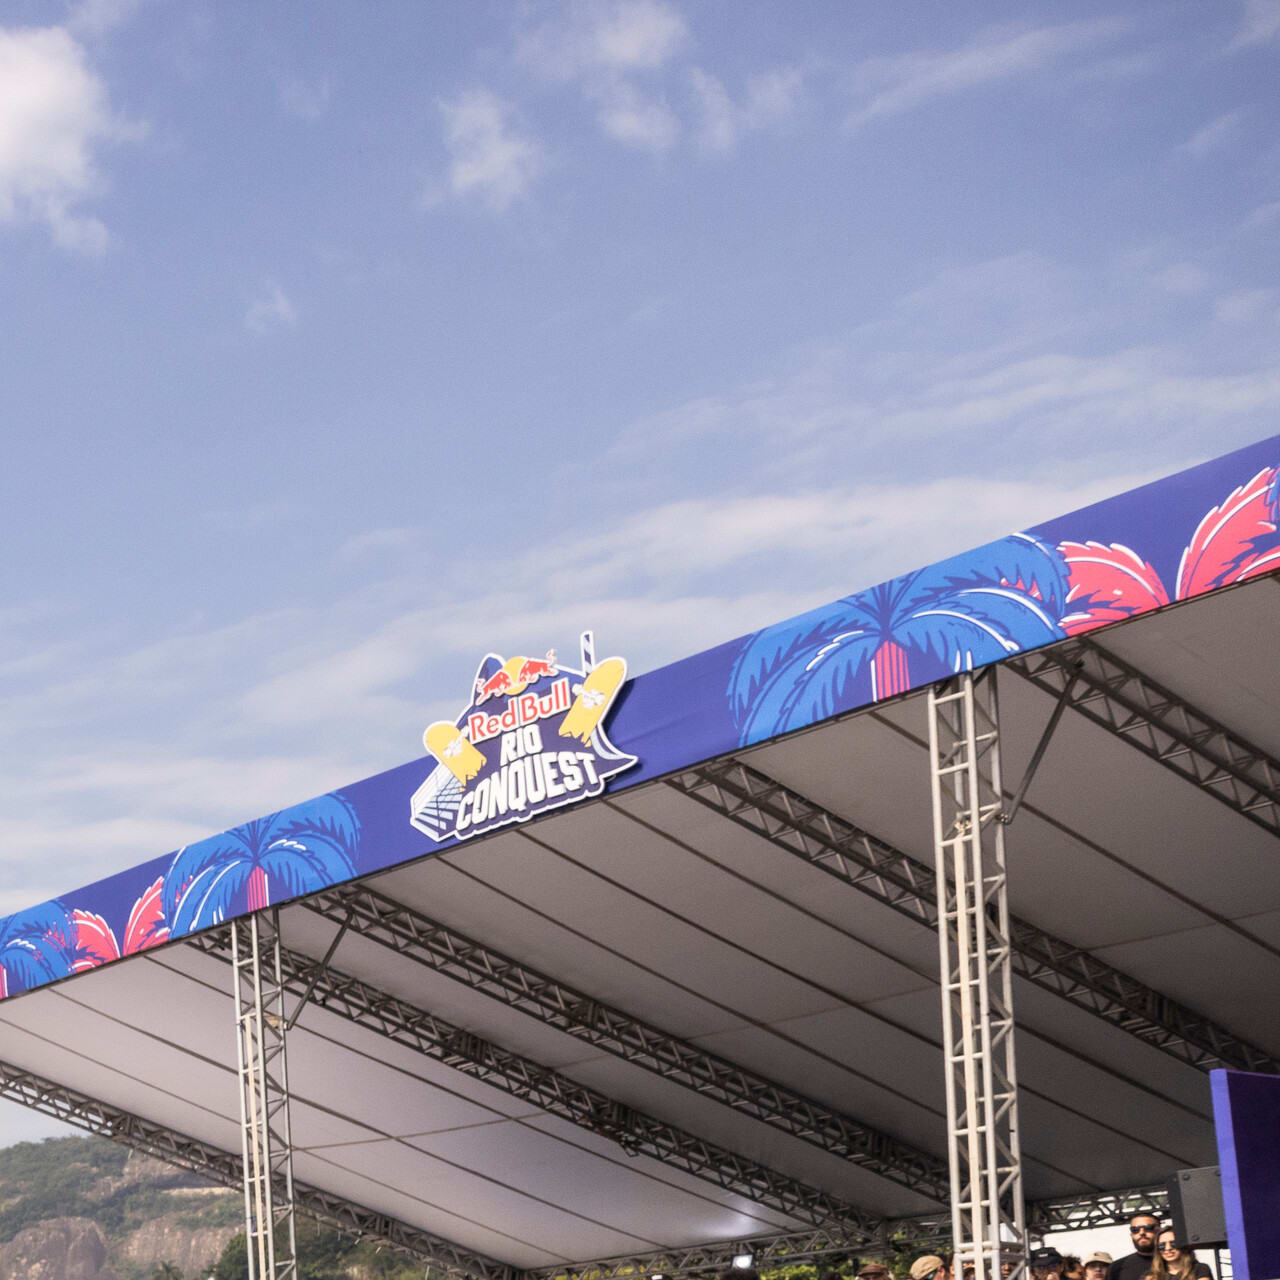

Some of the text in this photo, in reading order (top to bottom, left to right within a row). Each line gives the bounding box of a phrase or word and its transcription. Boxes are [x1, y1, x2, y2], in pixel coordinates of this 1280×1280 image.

[470, 681, 568, 741] Red Bull
[500, 724, 543, 766] RIO
[456, 752, 602, 831] CONQUEST
